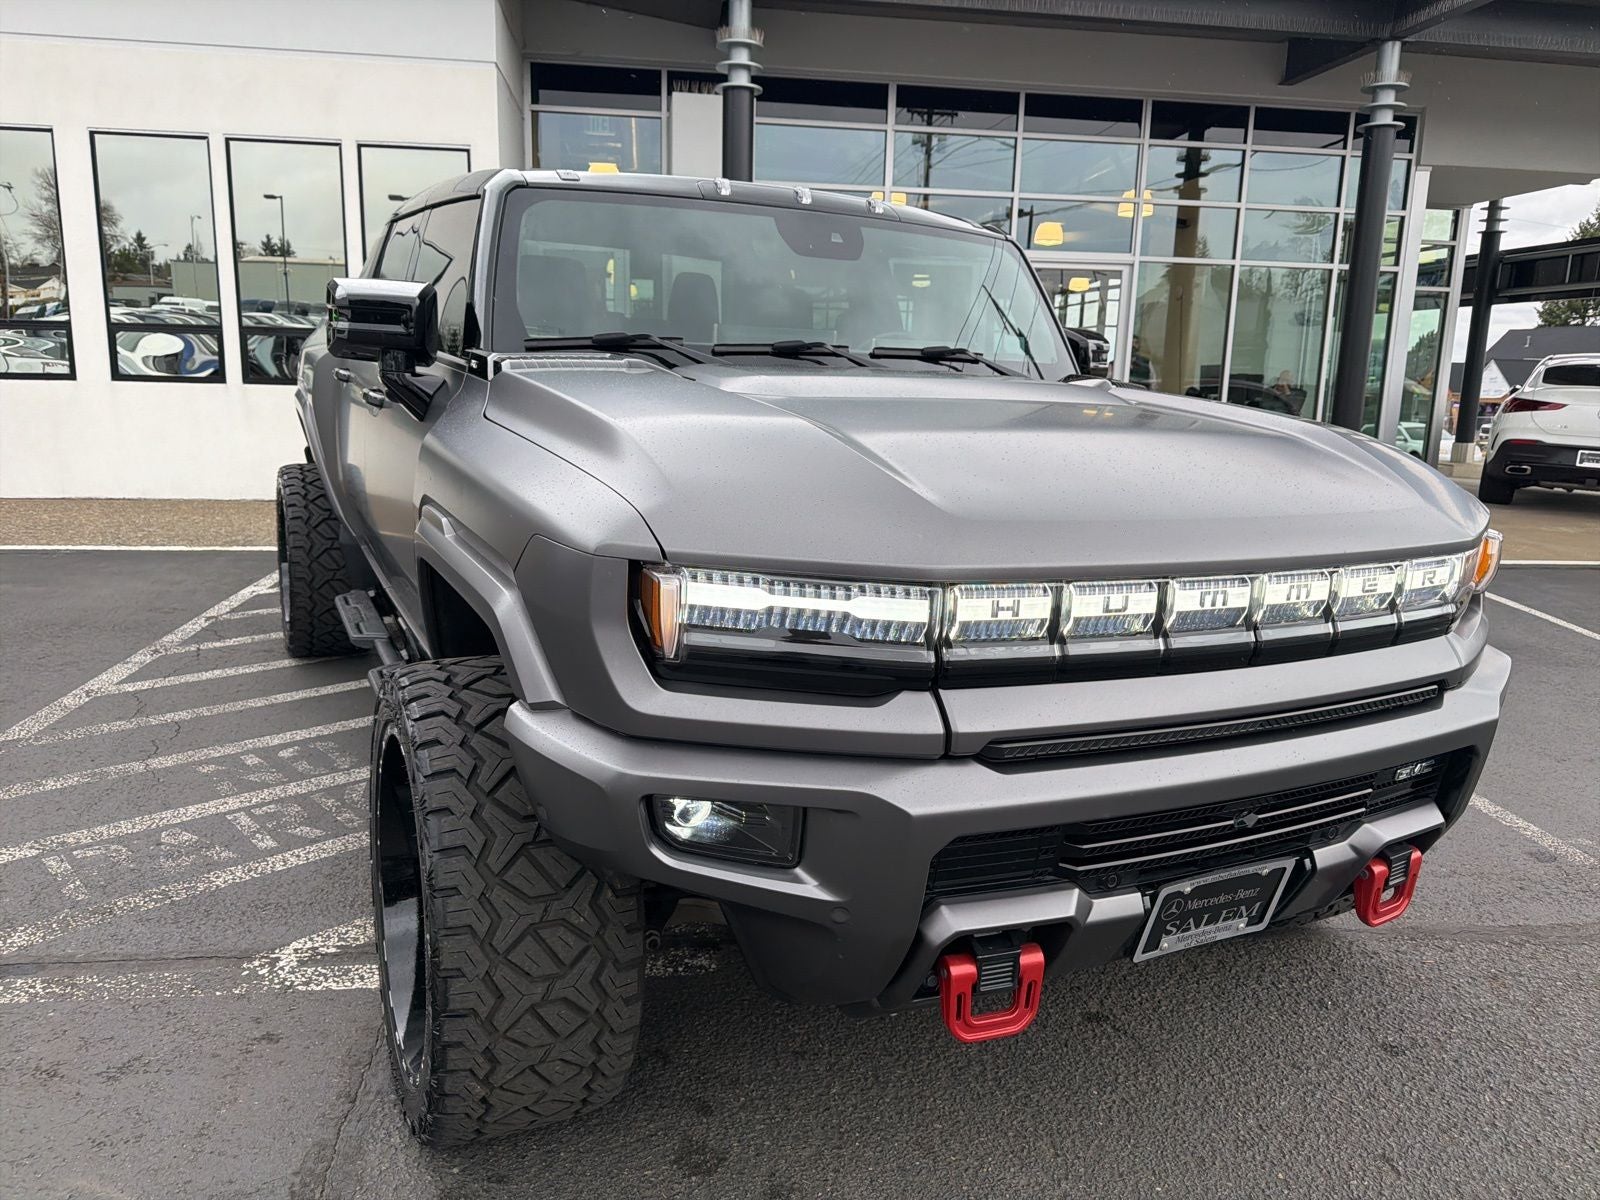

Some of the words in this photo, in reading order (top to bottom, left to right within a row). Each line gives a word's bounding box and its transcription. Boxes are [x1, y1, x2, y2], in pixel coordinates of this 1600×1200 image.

[991, 569, 1437, 618] HUMMER
[1184, 887, 1261, 911] Mercedes-Benz
[1164, 901, 1264, 938] SALEM
[1175, 923, 1233, 945] Mercedes-Benz
[1194, 935, 1218, 946] Salem
